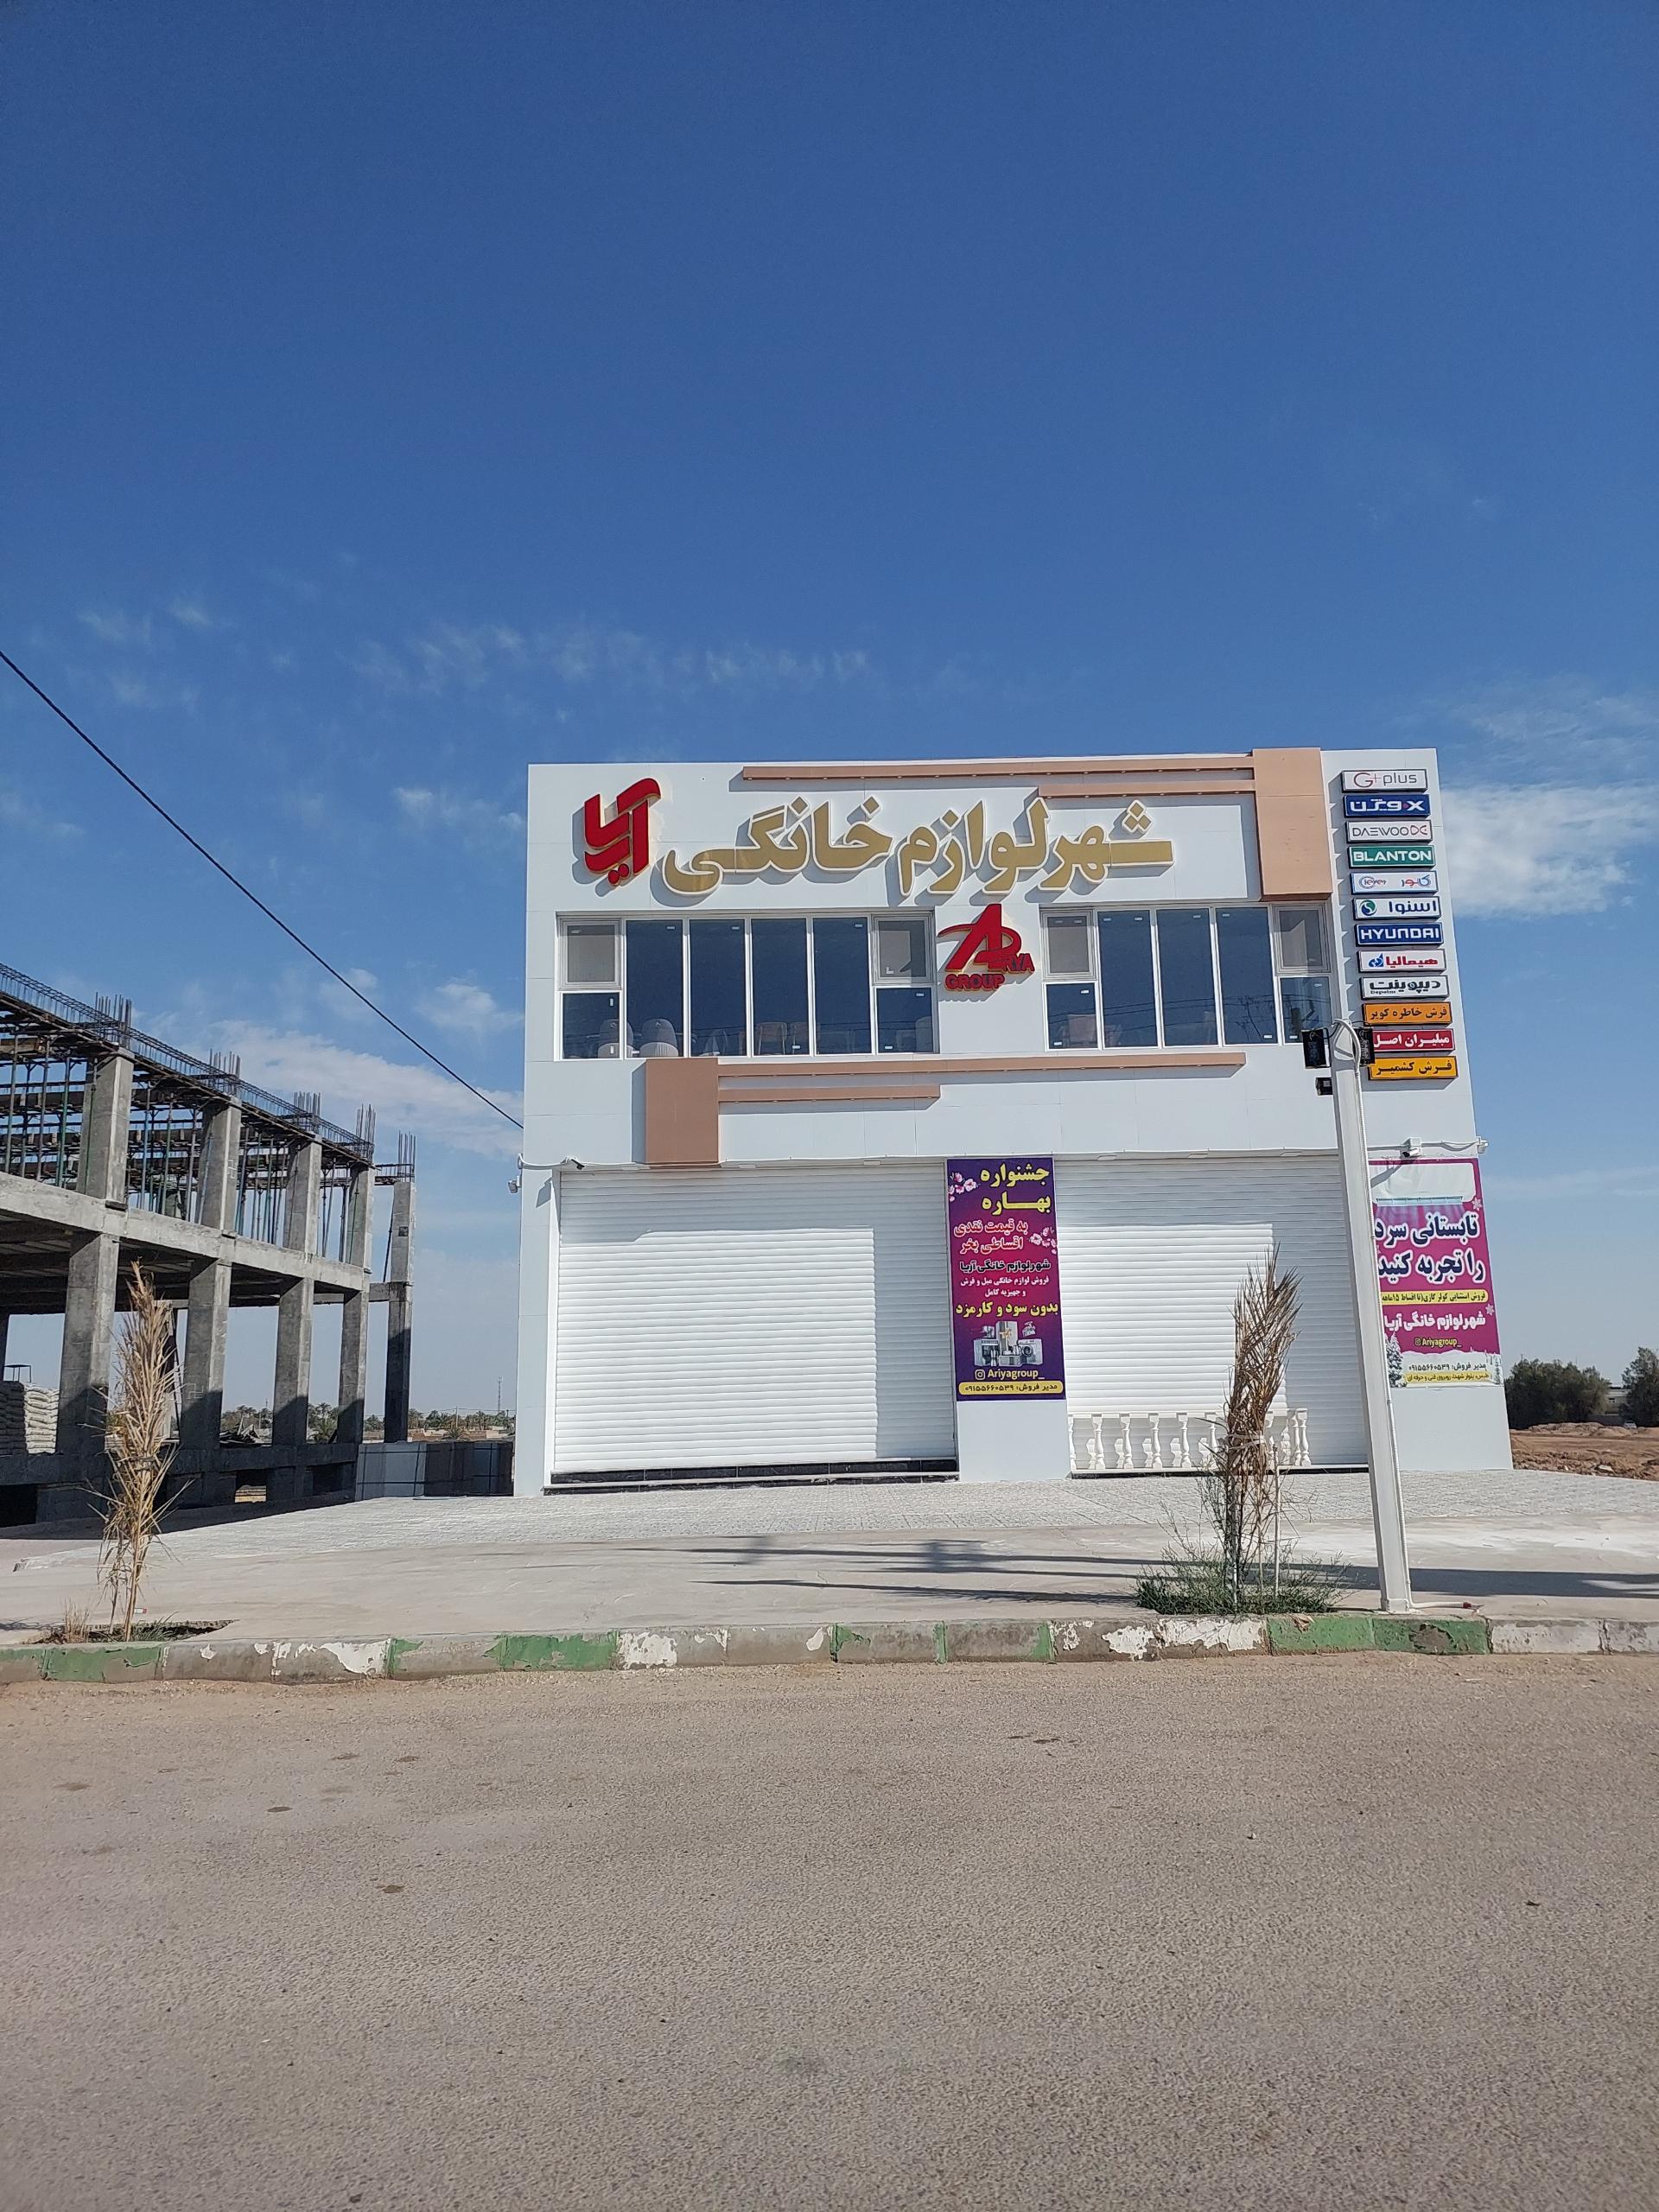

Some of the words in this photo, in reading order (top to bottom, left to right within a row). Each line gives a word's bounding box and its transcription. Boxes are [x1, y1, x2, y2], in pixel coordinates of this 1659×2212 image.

[1352, 825, 1409, 836] DAEWOO
[663, 795, 893, 896] خانگی
[895, 797, 1051, 898] لوازم
[1037, 798, 1174, 893] شهر
[1353, 850, 1432, 861] BLANTON
[1389, 900, 1437, 914] اسنوا
[1360, 927, 1440, 940] HYUNDAI
[1385, 956, 1439, 969] هیمالیا
[944, 973, 1005, 990] GROUP
[1369, 979, 1441, 994] دیپوینت
[1370, 1007, 1390, 1020] کویر
[1392, 1007, 1422, 1020] خاطره
[1425, 1006, 1447, 1019] فرش
[1374, 1033, 1402, 1048] اصل
[1376, 1061, 1414, 1076] کشمیر
[1418, 1059, 1452, 1074] فرش
[980, 1163, 1050, 1187] جشنواره
[981, 1191, 1052, 1216] بهاره
[953, 1219, 984, 1237] نقدی
[985, 1217, 1015, 1236] قیمت
[1015, 1220, 1028, 1236] به
[1375, 1220, 1408, 1246] سرد
[1411, 1211, 1478, 1246] تابستانی
[959, 1237, 979, 1255] بخر
[980, 1235, 1024, 1255] اقساطی
[959, 1260, 977, 1274] آریا
[977, 1258, 1006, 1274] خانگی
[1007, 1260, 1032, 1274] لوازم
[1378, 1250, 1412, 1281] کنید
[1417, 1250, 1464, 1282] تجربه
[1465, 1249, 1485, 1282] را
[960, 1277, 976, 1287] فرش
[993, 1276, 1013, 1286] خانگی
[1014, 1276, 1030, 1286] لوازم
[1031, 1275, 1050, 1286] فروش
[984, 1287, 1000, 1298] کامل
[956, 1300, 994, 1318] کارمزد
[995, 1305, 1003, 1317] و
[1005, 1302, 1027, 1317] سود
[1030, 1302, 1058, 1317] بدون
[1383, 1313, 1402, 1332] آریا
[1403, 1311, 1436, 1331] خانگی
[1437, 1313, 1463, 1331] لوازم
